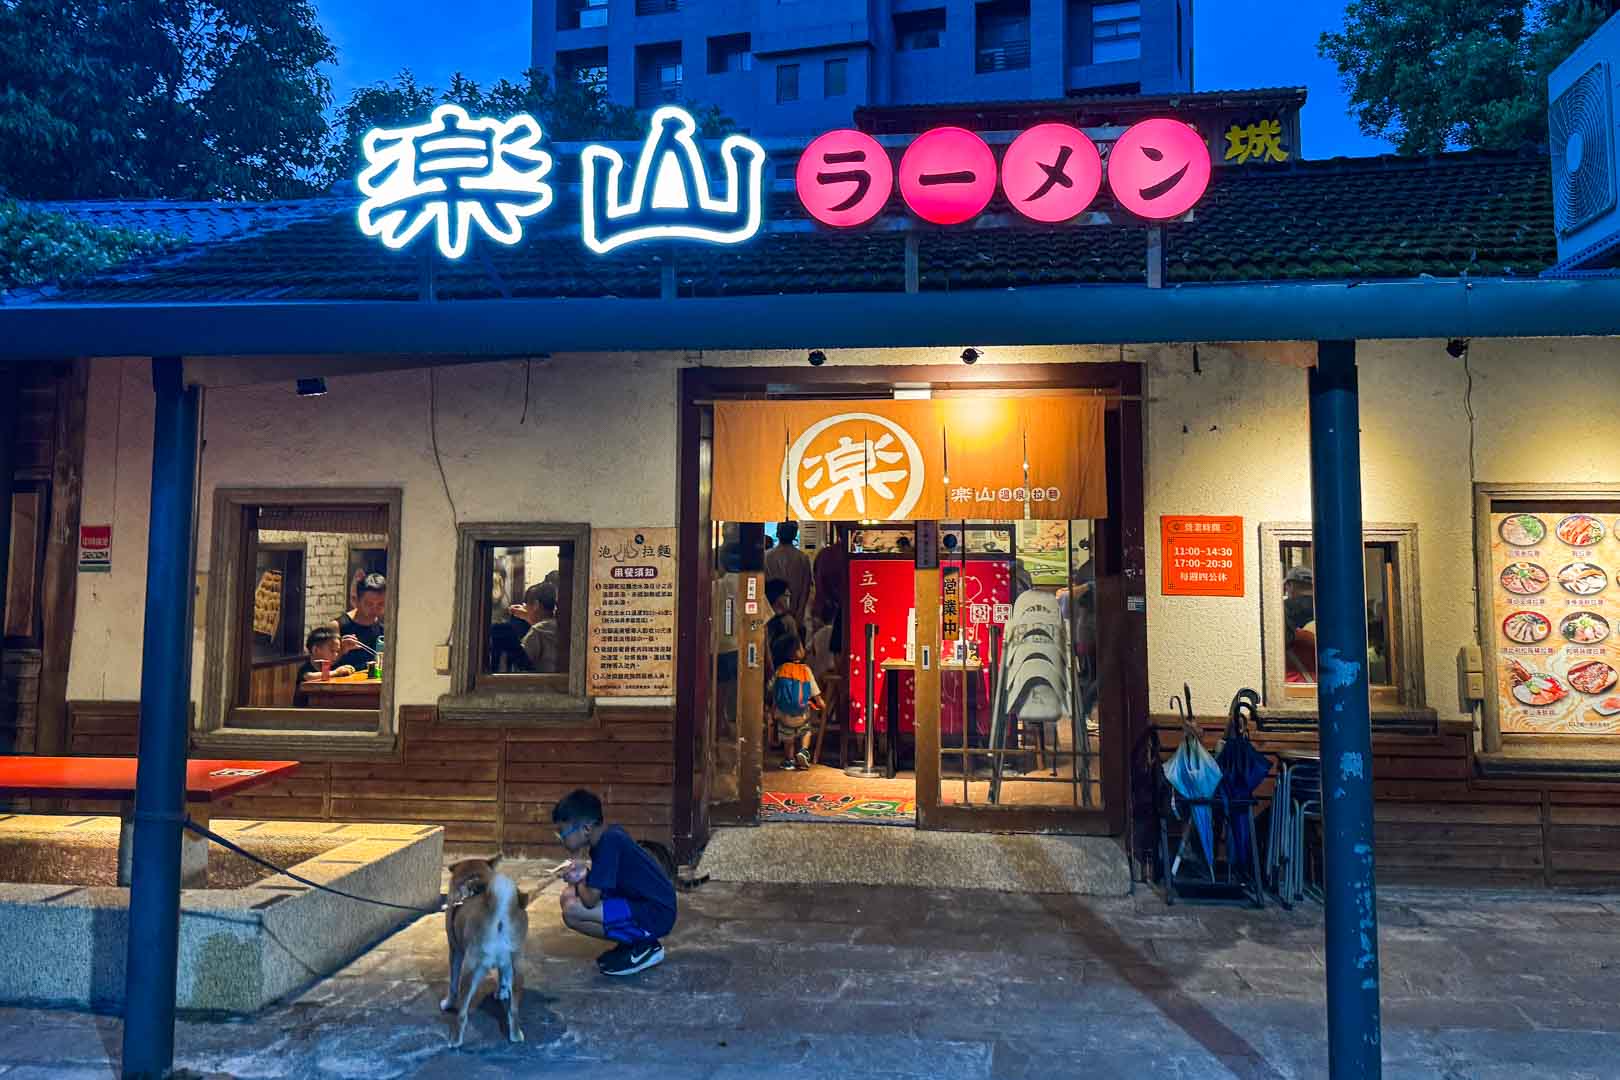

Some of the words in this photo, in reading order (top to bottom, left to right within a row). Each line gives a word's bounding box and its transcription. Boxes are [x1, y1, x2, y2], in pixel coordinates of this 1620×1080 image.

[1225, 120, 1289, 165] 城
[816, 145, 1189, 219] ラーメン
[859, 571, 878, 614] 立食
